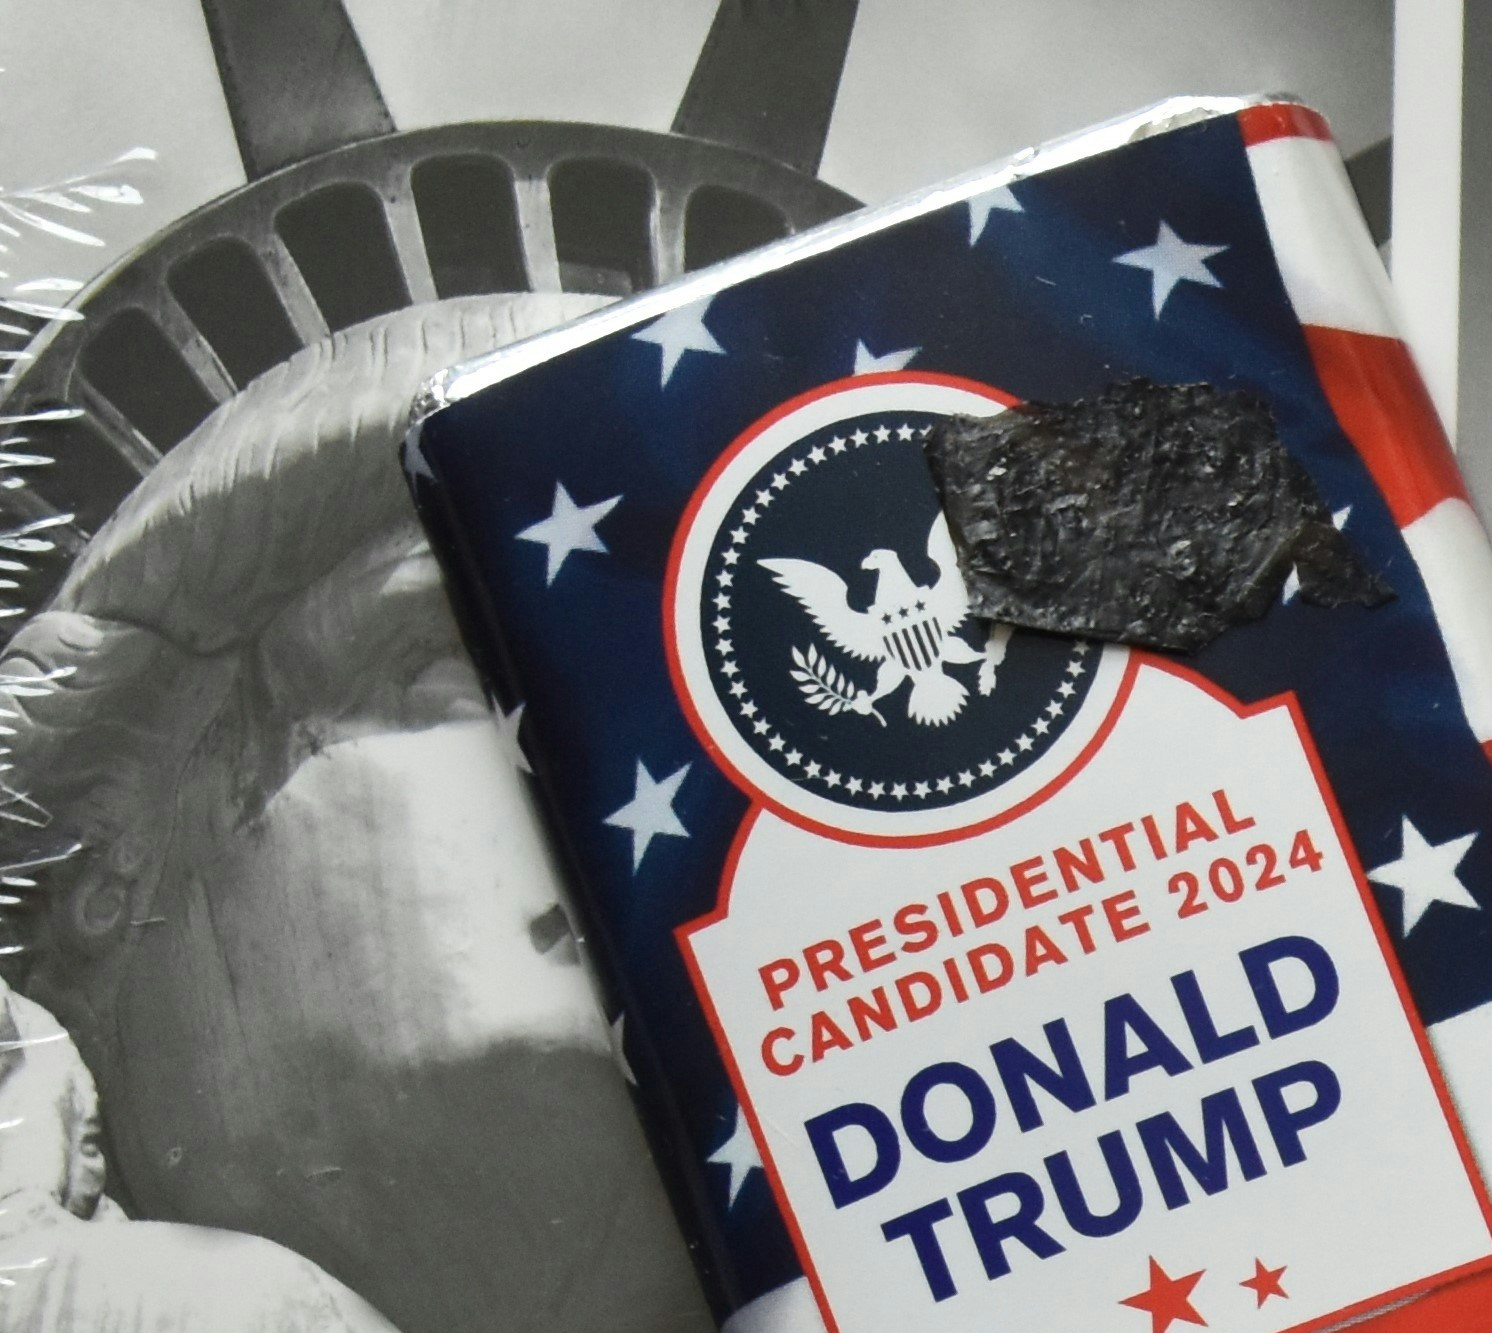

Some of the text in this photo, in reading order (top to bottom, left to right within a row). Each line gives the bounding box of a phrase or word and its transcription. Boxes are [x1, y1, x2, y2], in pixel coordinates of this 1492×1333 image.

[760, 791, 1254, 1009] PRESIDENTIAL
[762, 831, 1321, 1075] CANDIDATE 2024
[804, 935, 1342, 1208] DONALD
[881, 1060, 1344, 1301] TRUMP
